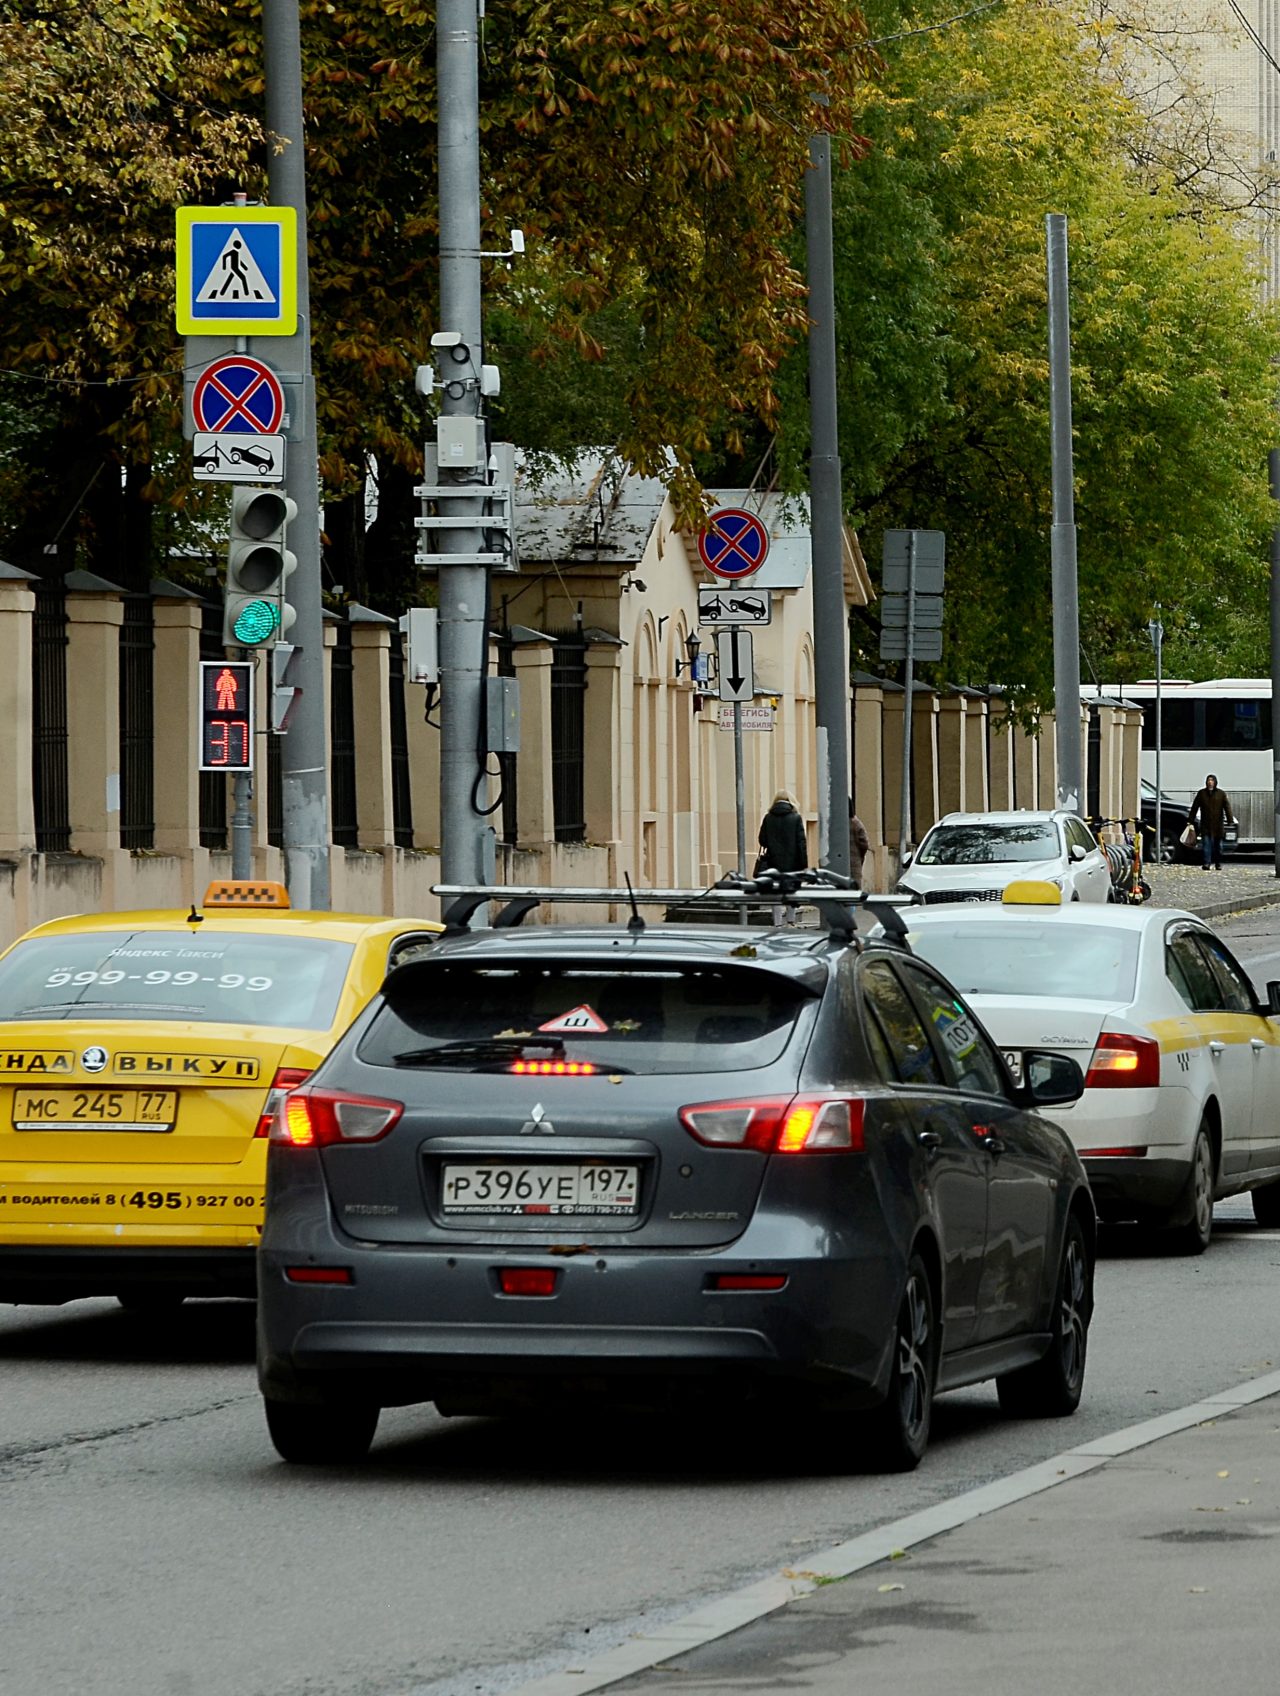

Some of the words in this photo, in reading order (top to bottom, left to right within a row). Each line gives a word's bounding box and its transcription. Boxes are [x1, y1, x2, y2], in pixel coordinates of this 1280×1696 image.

[724, 709, 770, 717] БЕЕГИСЬ
[721, 721, 772, 729] АВТМОБИЛЯ
[211, 720, 248, 764] 37
[109, 948, 172, 958] Яндекс
[176, 948, 225, 959] Такси
[45, 970, 273, 992] 999-99-99
[564, 1018, 589, 1027] Ш
[0, 1054, 69, 1073] НДА
[119, 1056, 254, 1076] ВЫКУП
[26, 1099, 59, 1118] МС
[72, 1094, 124, 1118] 245
[141, 1093, 167, 1112] 77
[454, 1170, 574, 1200] Р396УЕ
[583, 1169, 629, 1191] 197
[12, 1193, 100, 1205] водителей
[105, 1194, 116, 1205] 8
[196, 1196, 228, 1207] 927
[233, 1197, 255, 1207] 00
[668, 1211, 738, 1220] LANCER
